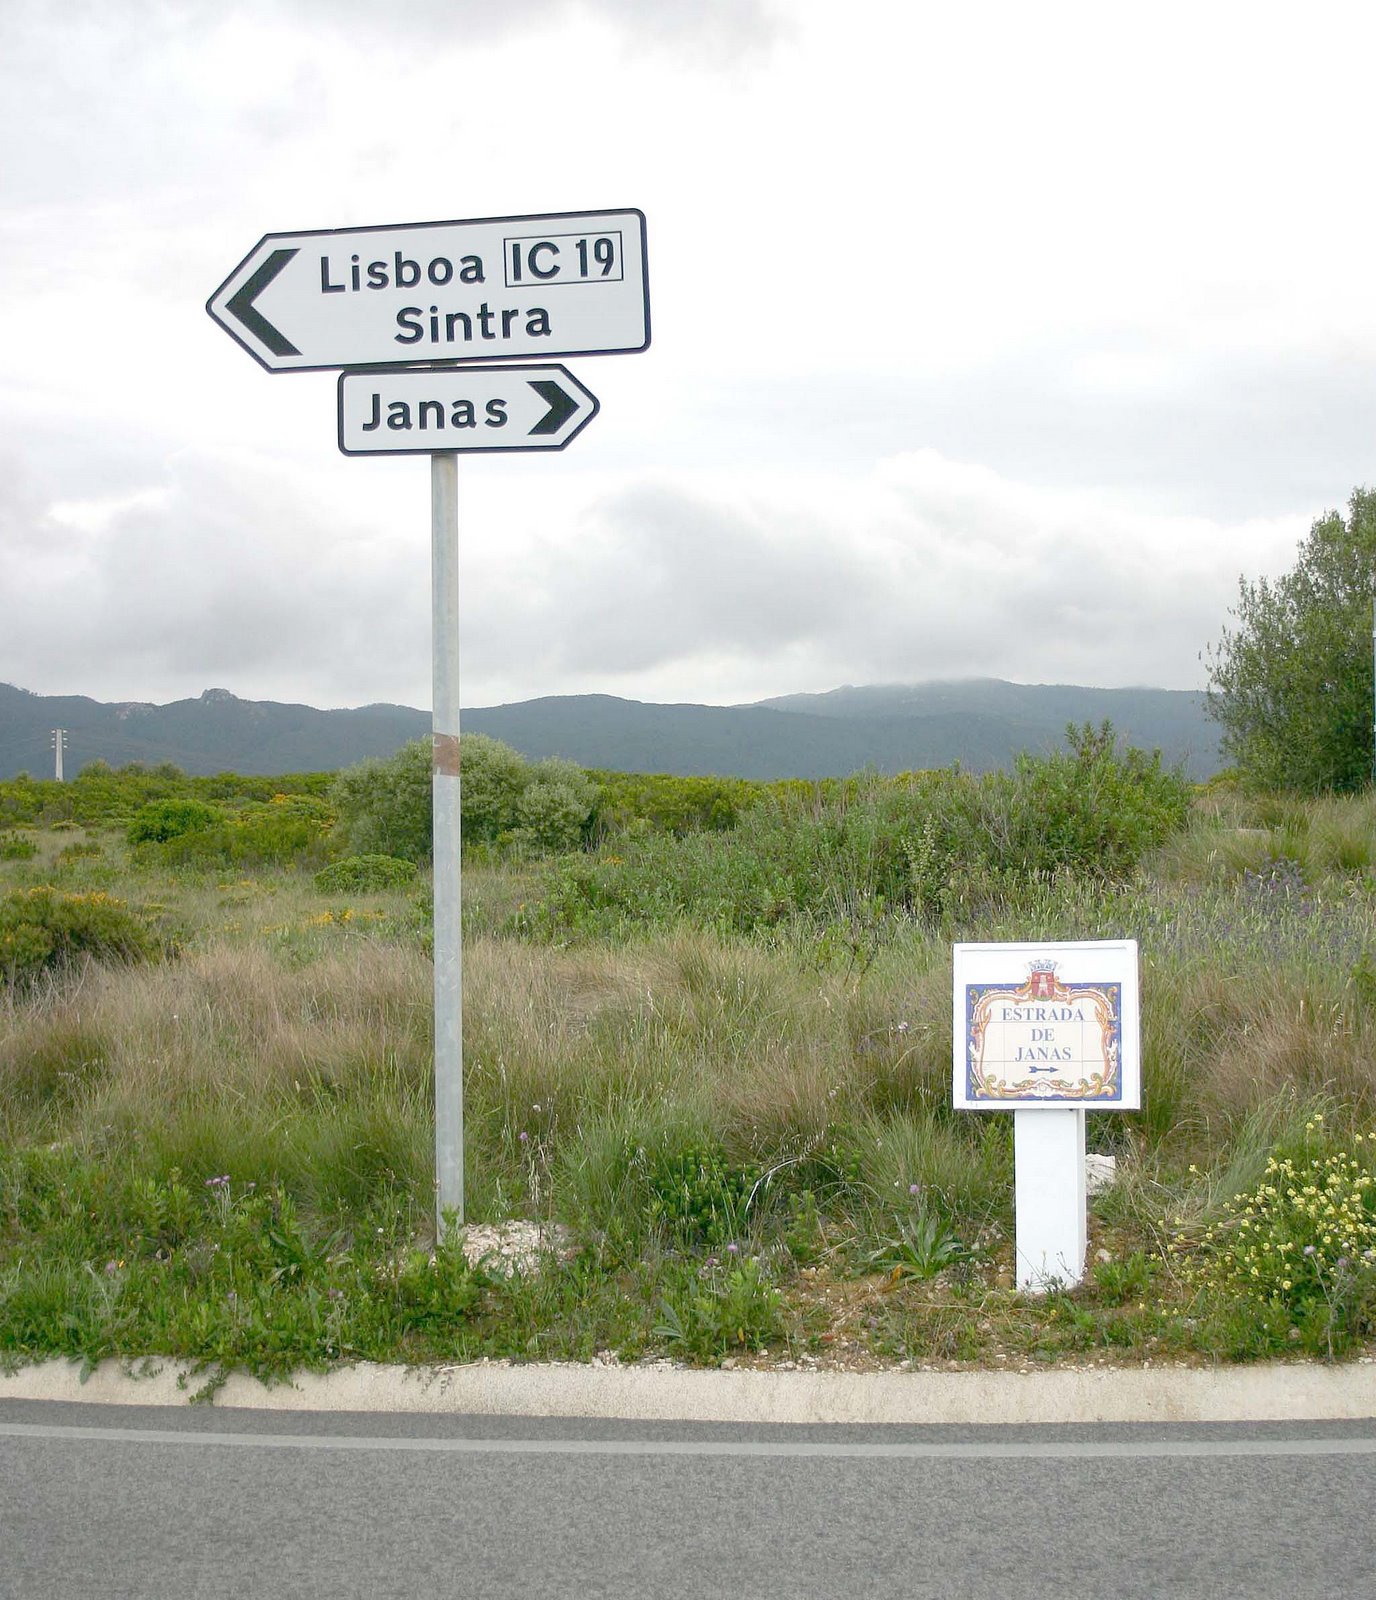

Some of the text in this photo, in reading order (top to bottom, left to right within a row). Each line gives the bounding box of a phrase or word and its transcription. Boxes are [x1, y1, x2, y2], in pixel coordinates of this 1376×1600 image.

[320, 237, 615, 294] Lisboa IC 19
[393, 302, 553, 345] Sintra
[361, 393, 510, 432] Janas
[1002, 1007, 1086, 1021] ESTRADA
[1031, 1028, 1055, 1042] DE
[1014, 1046, 1072, 1062] JANAS
